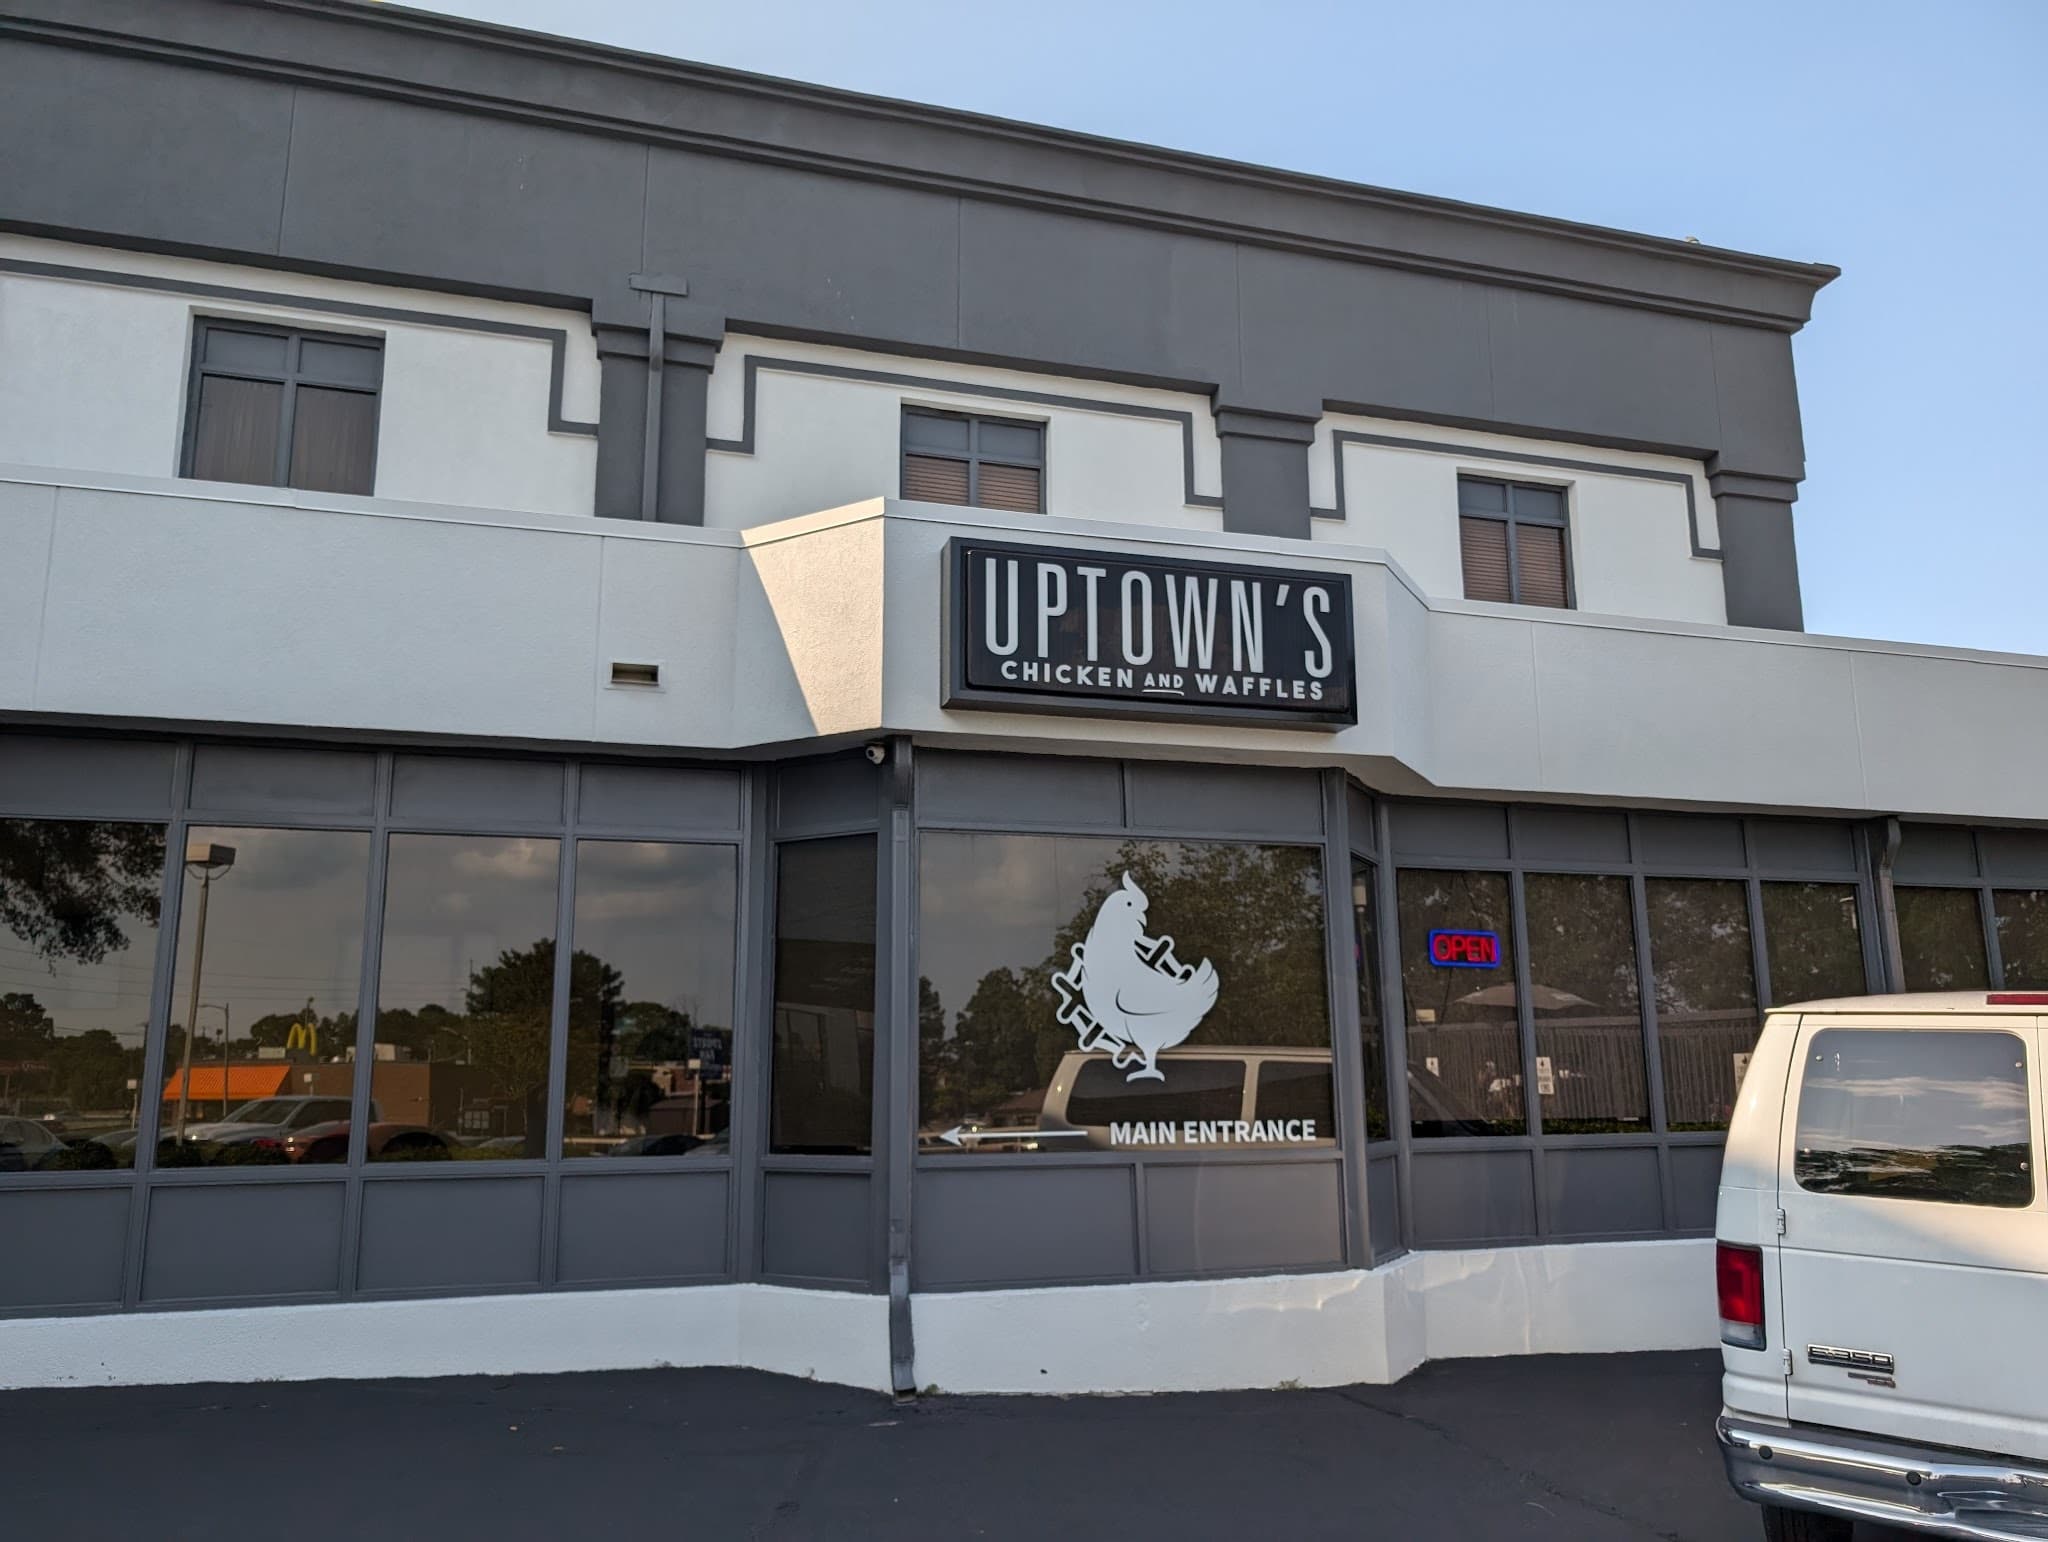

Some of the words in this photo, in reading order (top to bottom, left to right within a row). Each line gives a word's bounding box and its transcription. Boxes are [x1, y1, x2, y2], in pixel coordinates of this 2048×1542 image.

[986, 557, 1333, 679] UPTOWN'S
[1000, 660, 1133, 689] CHICKEN
[1143, 672, 1184, 689] AND
[1194, 673, 1323, 701] WAFFLES
[1432, 934, 1497, 962] OPEN
[1110, 1121, 1176, 1145] MAIN
[1183, 1119, 1317, 1144] ENTRANCE
